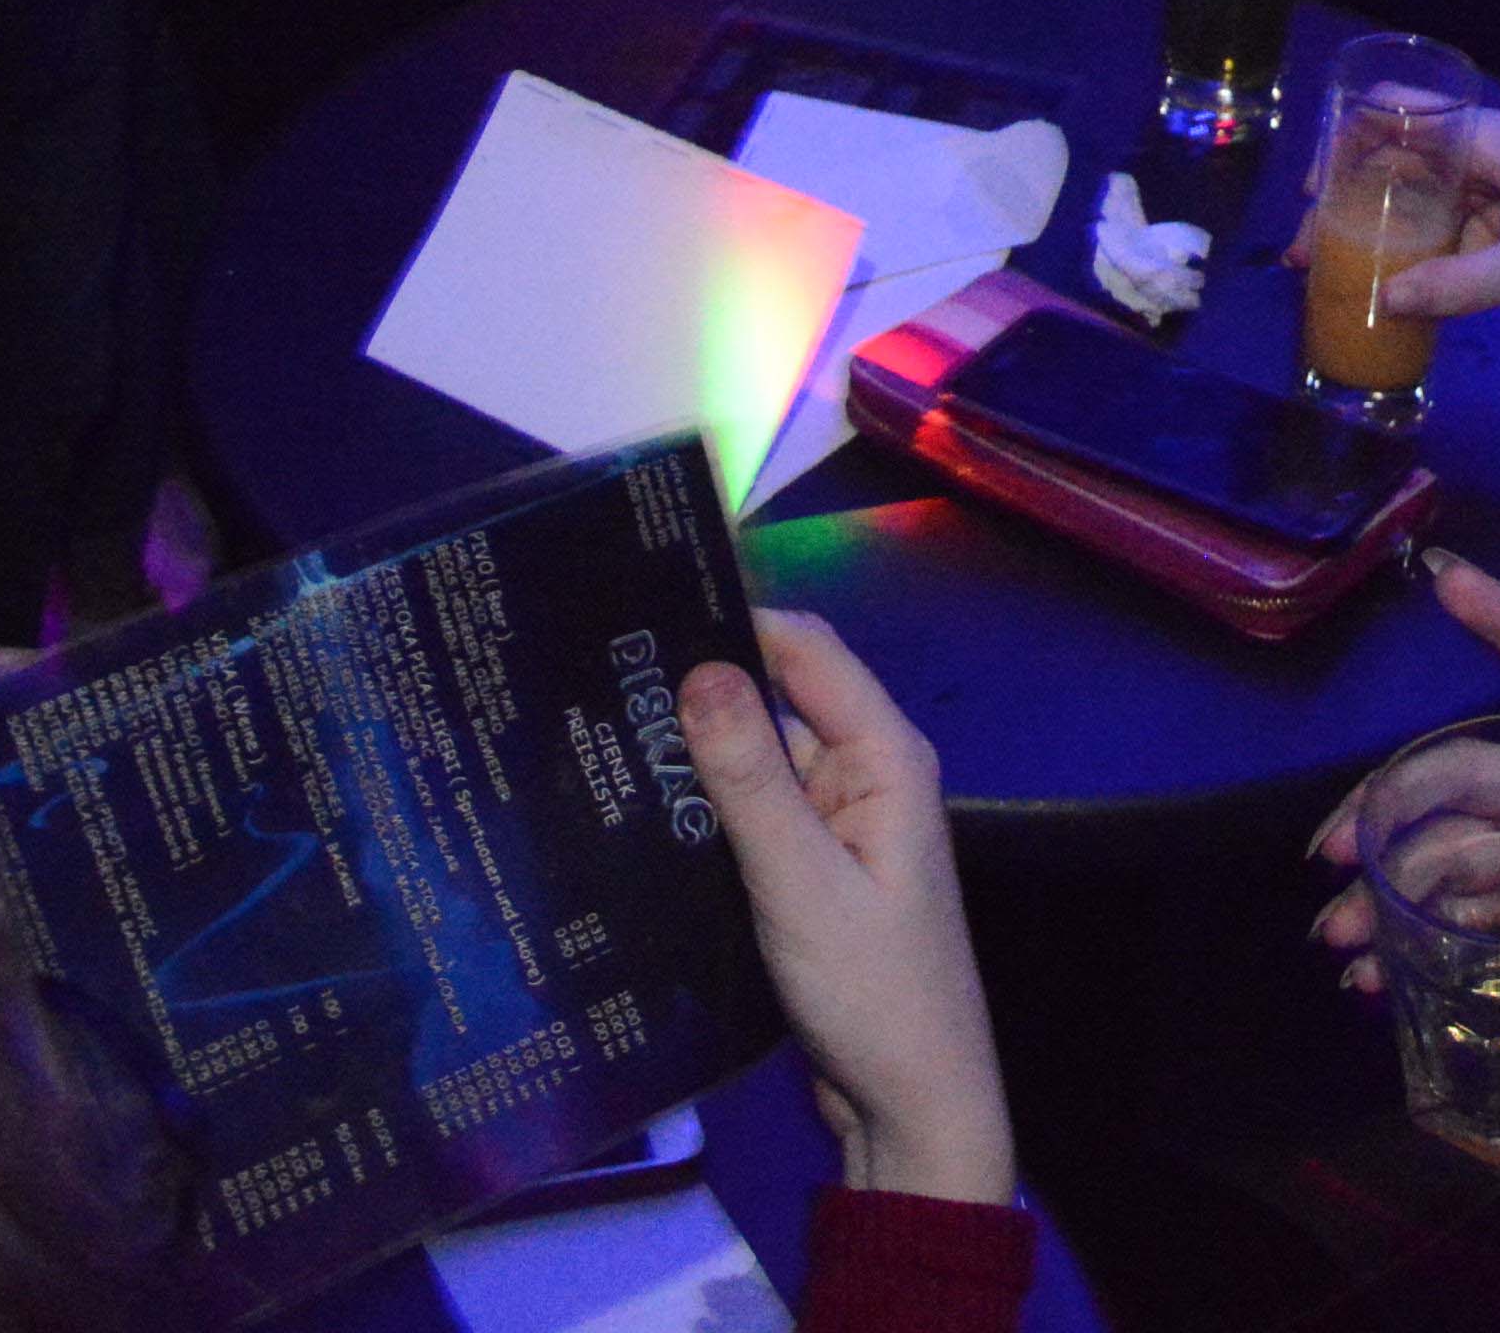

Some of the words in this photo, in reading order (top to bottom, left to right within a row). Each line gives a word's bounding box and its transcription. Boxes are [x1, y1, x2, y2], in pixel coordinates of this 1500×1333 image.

[466, 527, 496, 577] PIVO
[485, 588, 512, 630] Beer
[208, 628, 238, 682] VINA
[230, 695, 262, 753] Weine
[407, 648, 438, 696] PIĆA
[426, 706, 461, 774] LIKERI
[561, 704, 623, 828] PREISLISTE
[591, 719, 637, 800] CJENIK
[450, 787, 505, 890] Spirituosen
[493, 887, 519, 922] und
[600, 1042, 617, 1062] kn
[616, 1034, 632, 1054] kn
[349, 1164, 367, 1184] kn
[382, 1148, 400, 1168] kn
